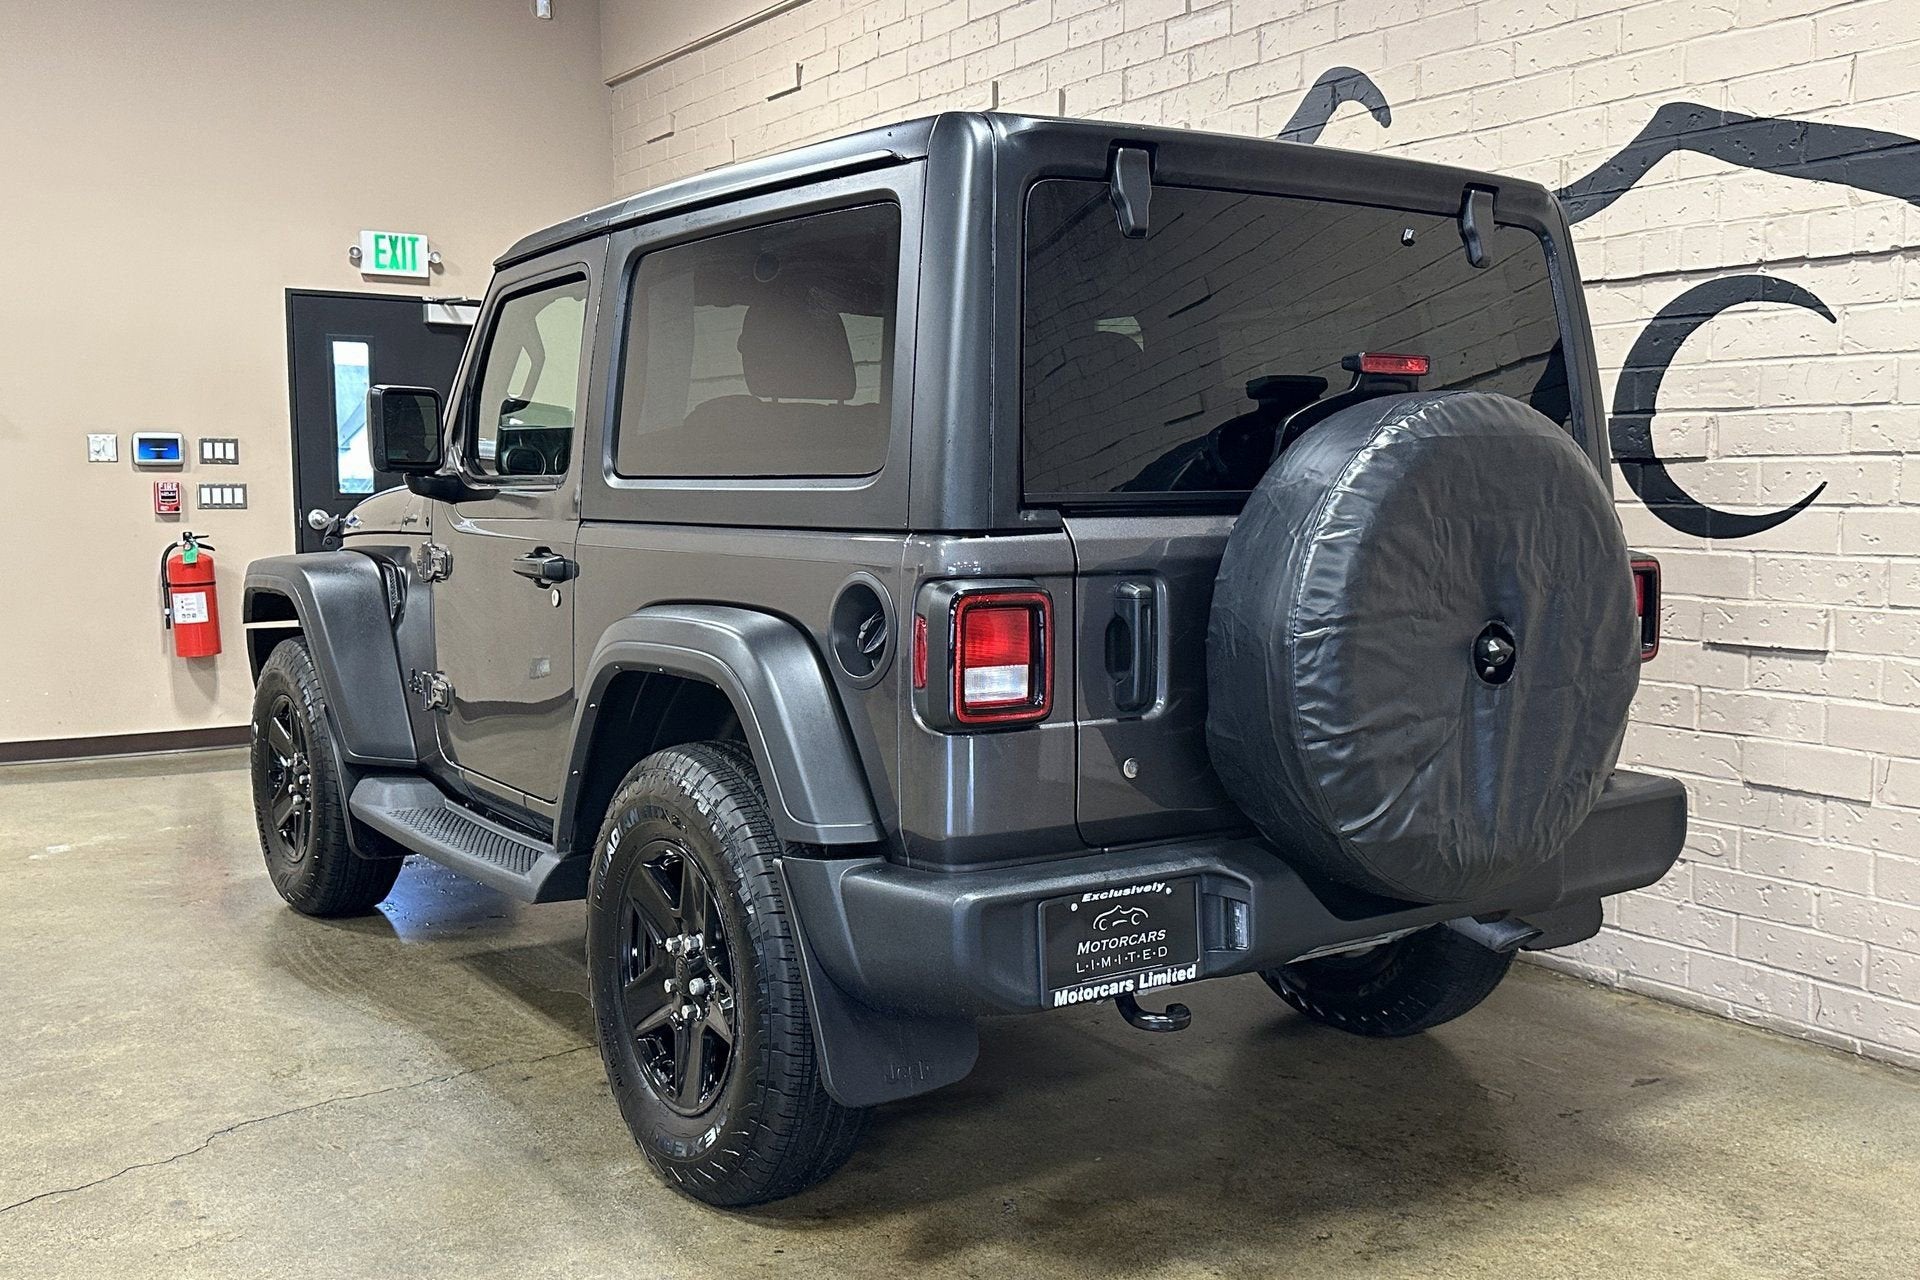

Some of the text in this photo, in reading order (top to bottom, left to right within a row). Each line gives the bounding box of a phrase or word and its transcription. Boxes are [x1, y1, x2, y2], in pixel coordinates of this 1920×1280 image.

[374, 234, 419, 271] EXIT
[159, 482, 178, 490] FIRE
[1081, 882, 1166, 903] Exclusively
[1077, 929, 1167, 956] MOTORCARS
[1054, 964, 1197, 1007] Motorcars Limited
